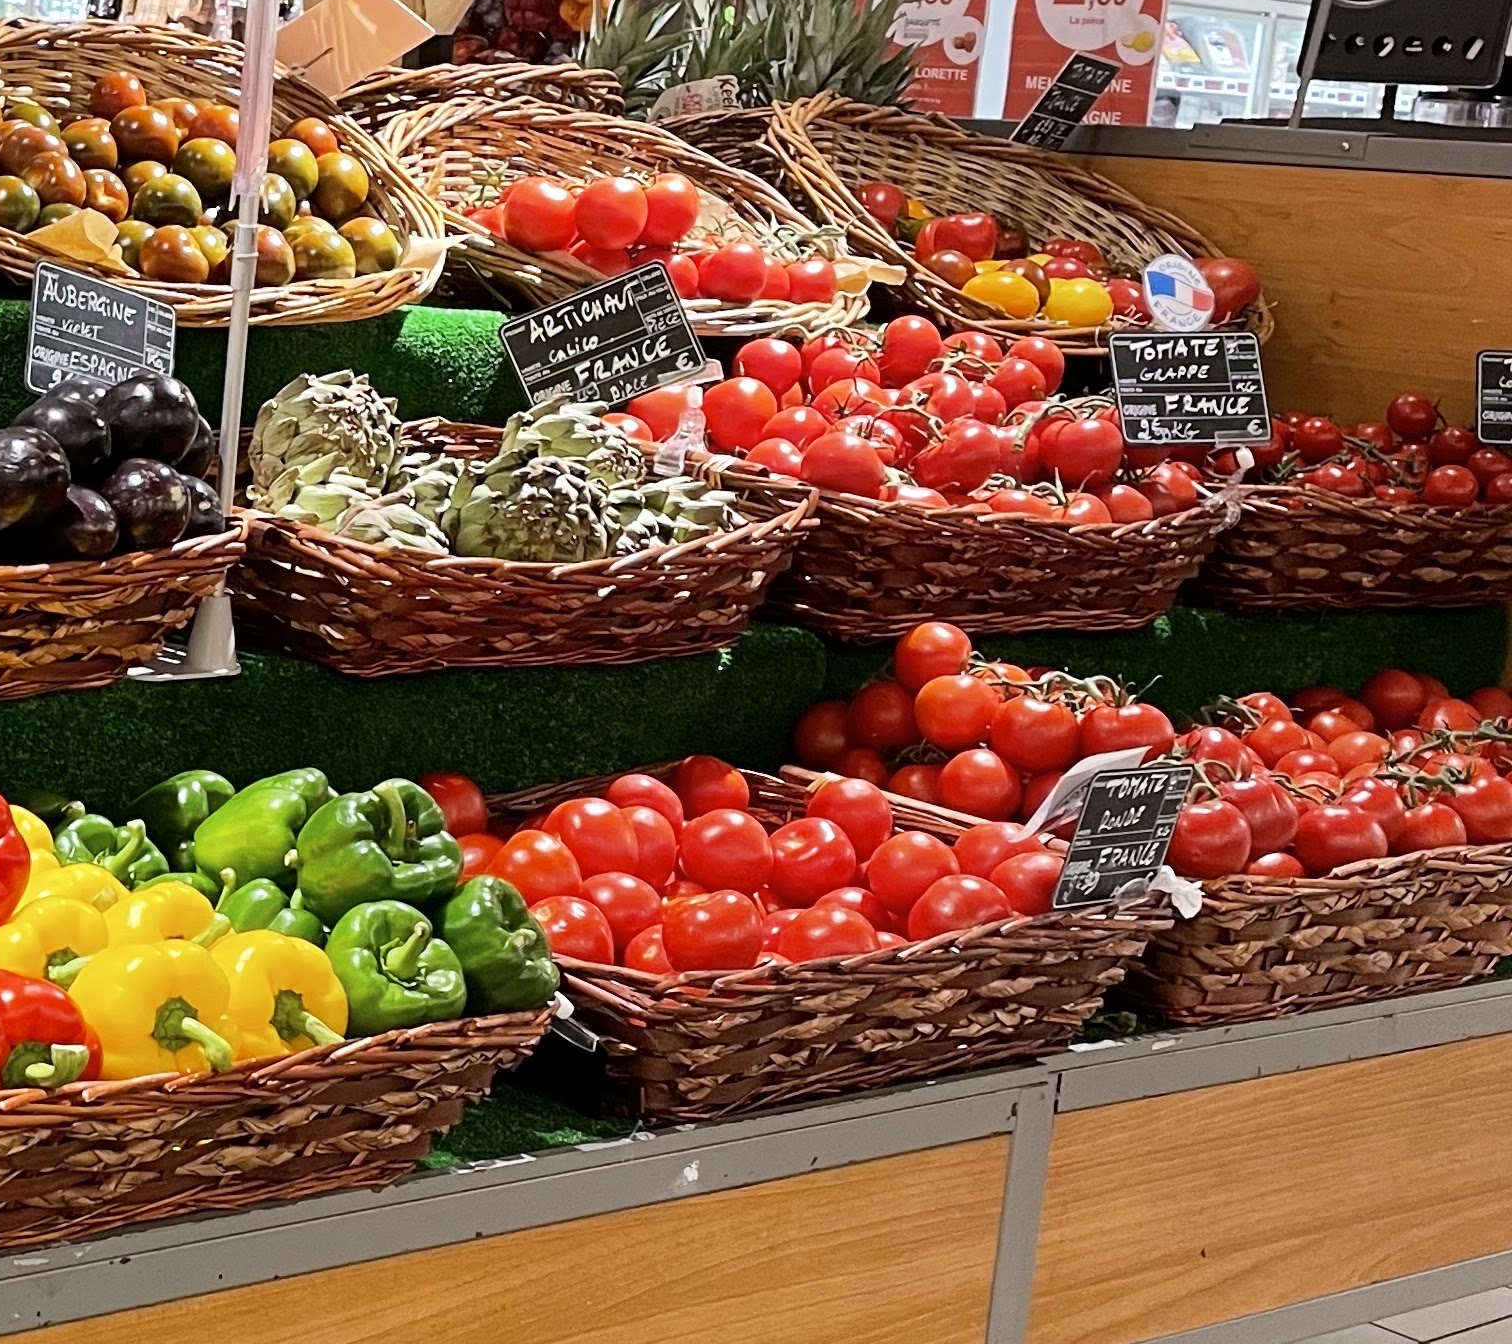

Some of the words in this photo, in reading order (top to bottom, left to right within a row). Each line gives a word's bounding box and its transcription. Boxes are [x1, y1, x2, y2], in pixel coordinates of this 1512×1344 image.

[528, 279, 640, 344] ARTICHAUT
[574, 335, 672, 386] FRANCE
[1129, 338, 1221, 363] TOMATE
[69, 351, 141, 382] ESPAGNE
[1139, 364, 1210, 382] GRAPPE
[1164, 394, 1252, 416] FRANCE
[1094, 842, 1160, 871] FRANCE
